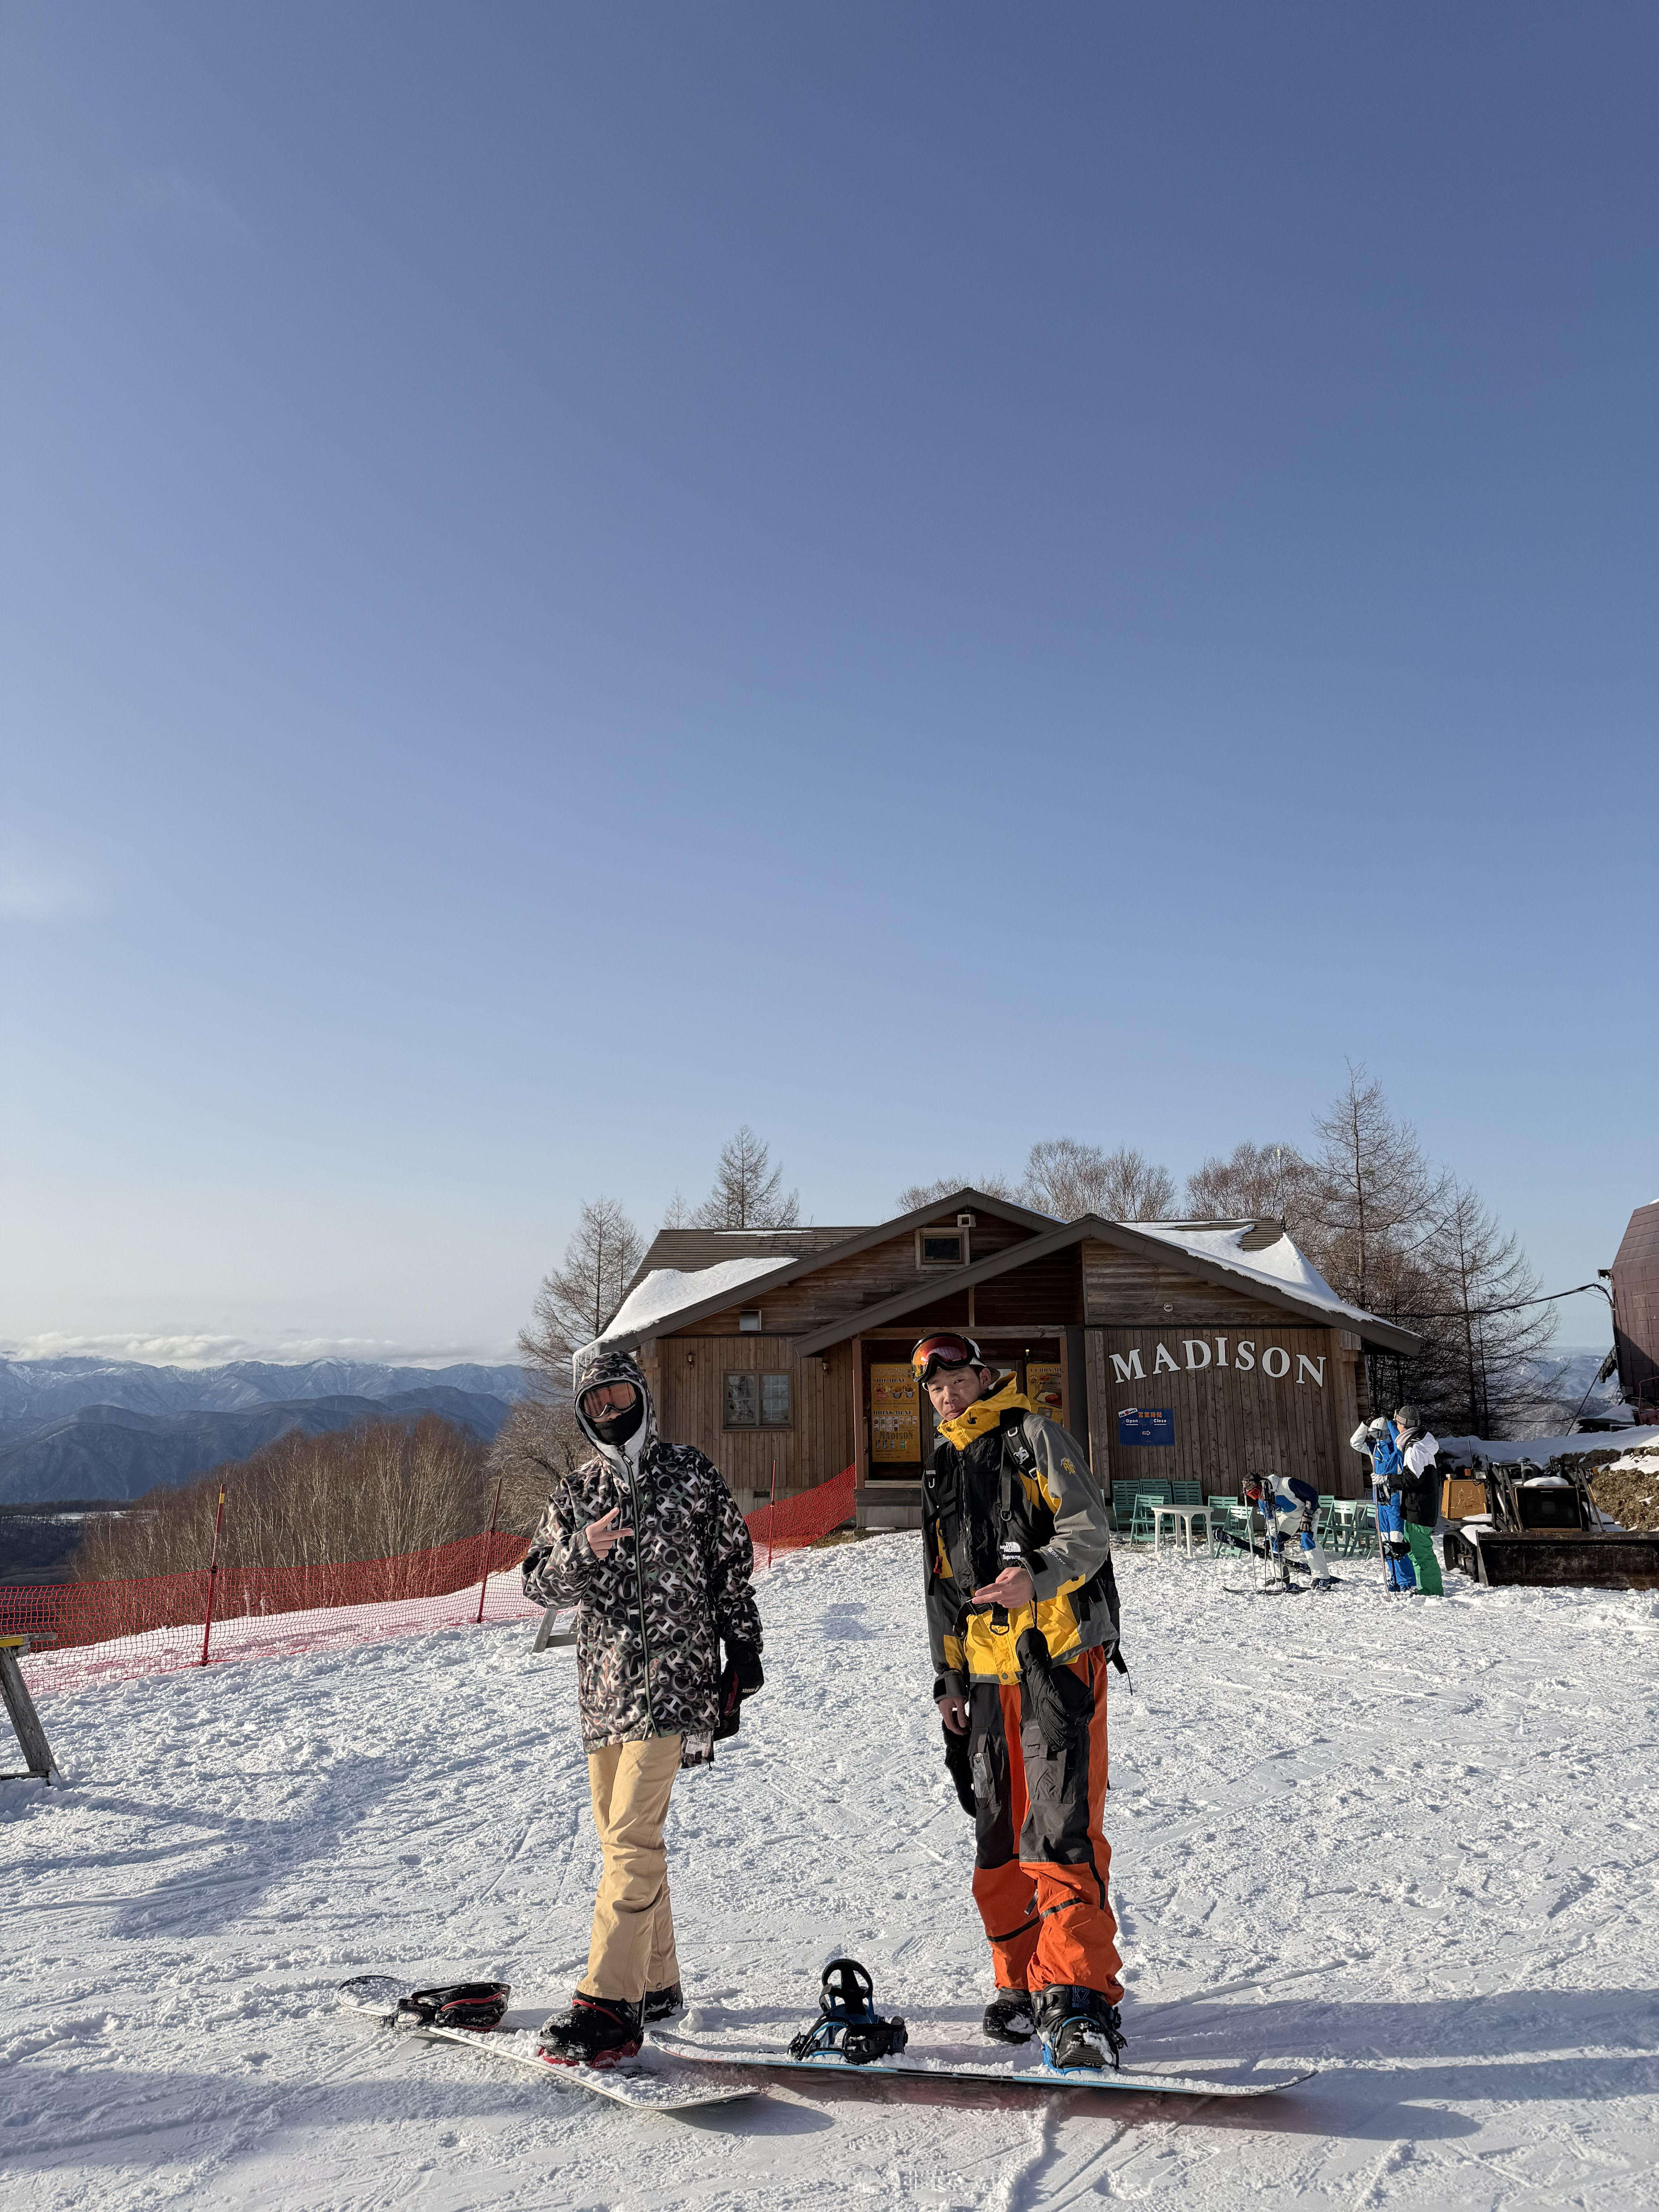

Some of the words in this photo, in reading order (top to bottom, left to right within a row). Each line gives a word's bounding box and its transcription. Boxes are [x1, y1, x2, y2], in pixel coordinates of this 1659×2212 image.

[1109, 1337, 1326, 1387] MADISON
[879, 1430, 913, 1439] MADISON
[1072, 1986, 1090, 2004] K2
